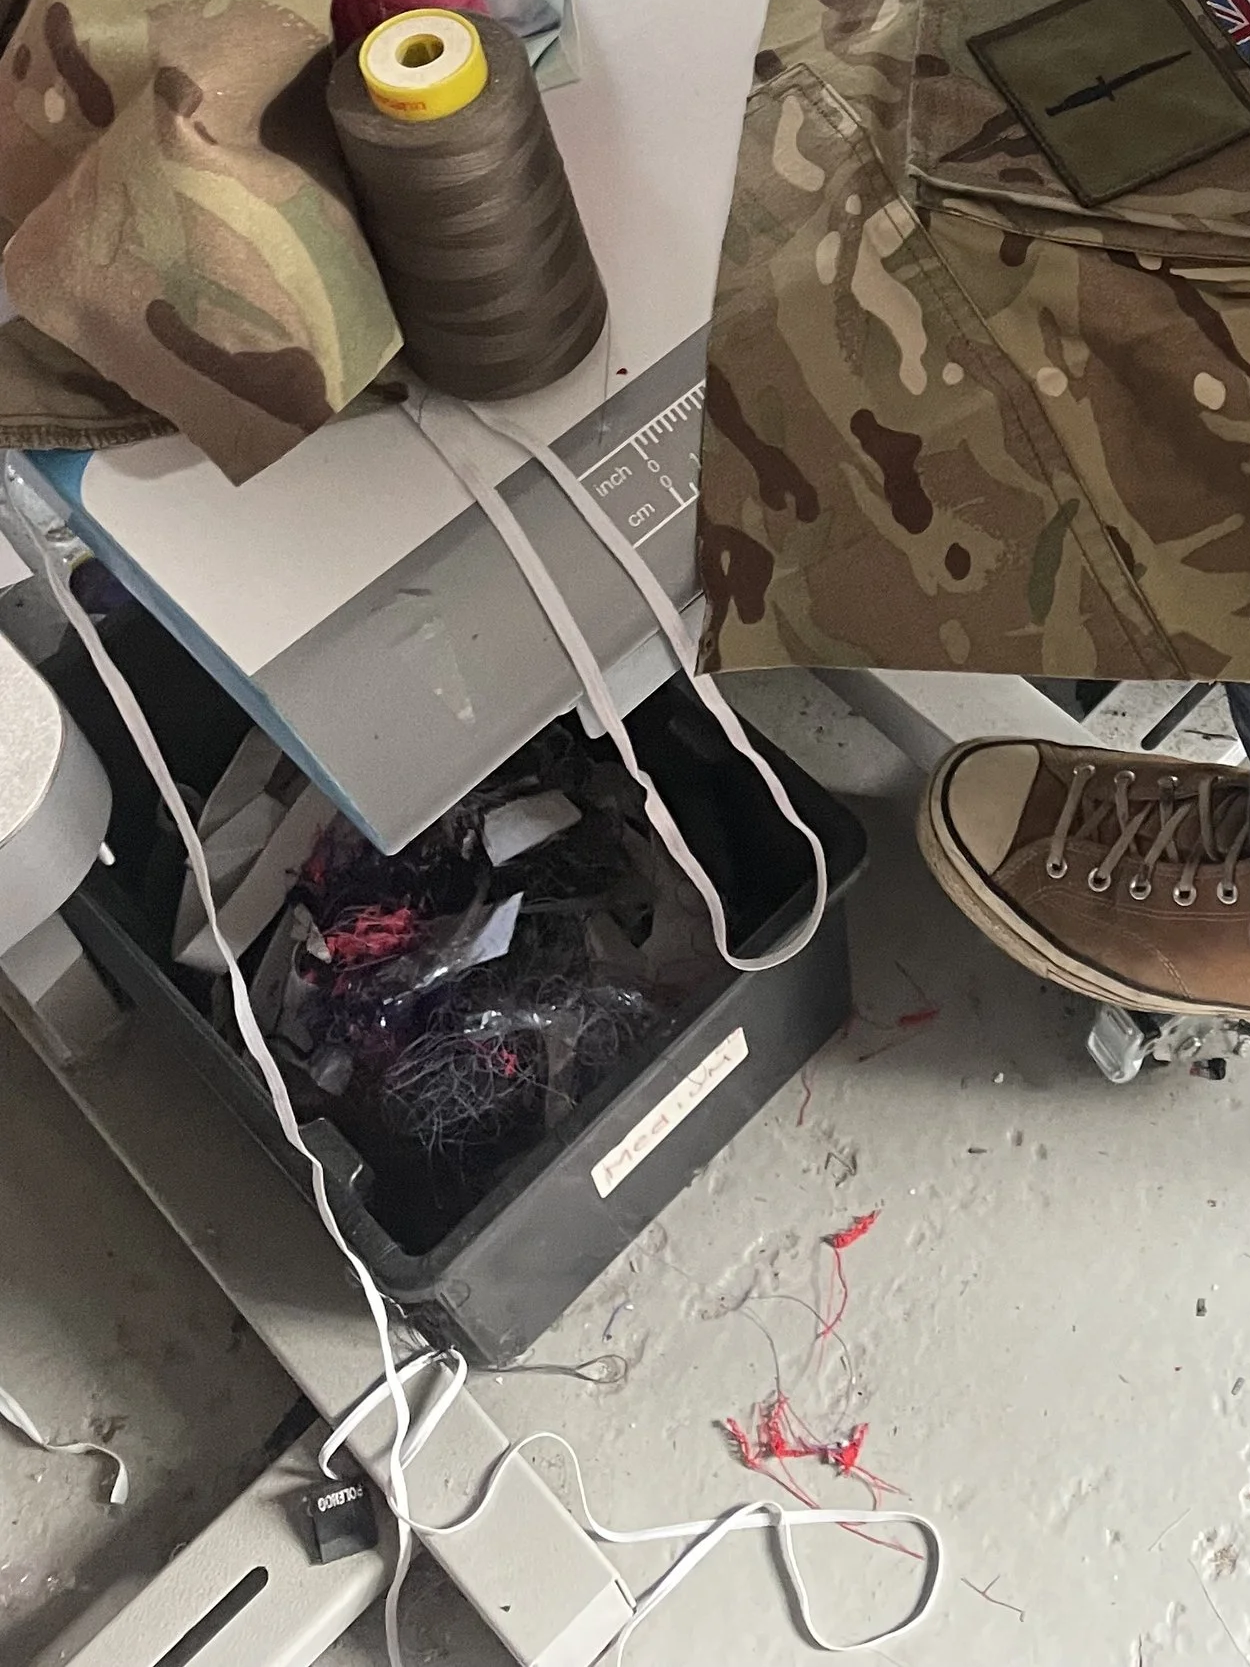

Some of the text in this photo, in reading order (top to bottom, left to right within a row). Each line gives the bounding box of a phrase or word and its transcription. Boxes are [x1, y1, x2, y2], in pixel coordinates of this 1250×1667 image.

[593, 459, 660, 497] inch 0
[628, 503, 656, 527] cm
[660, 475, 673, 488] 0
